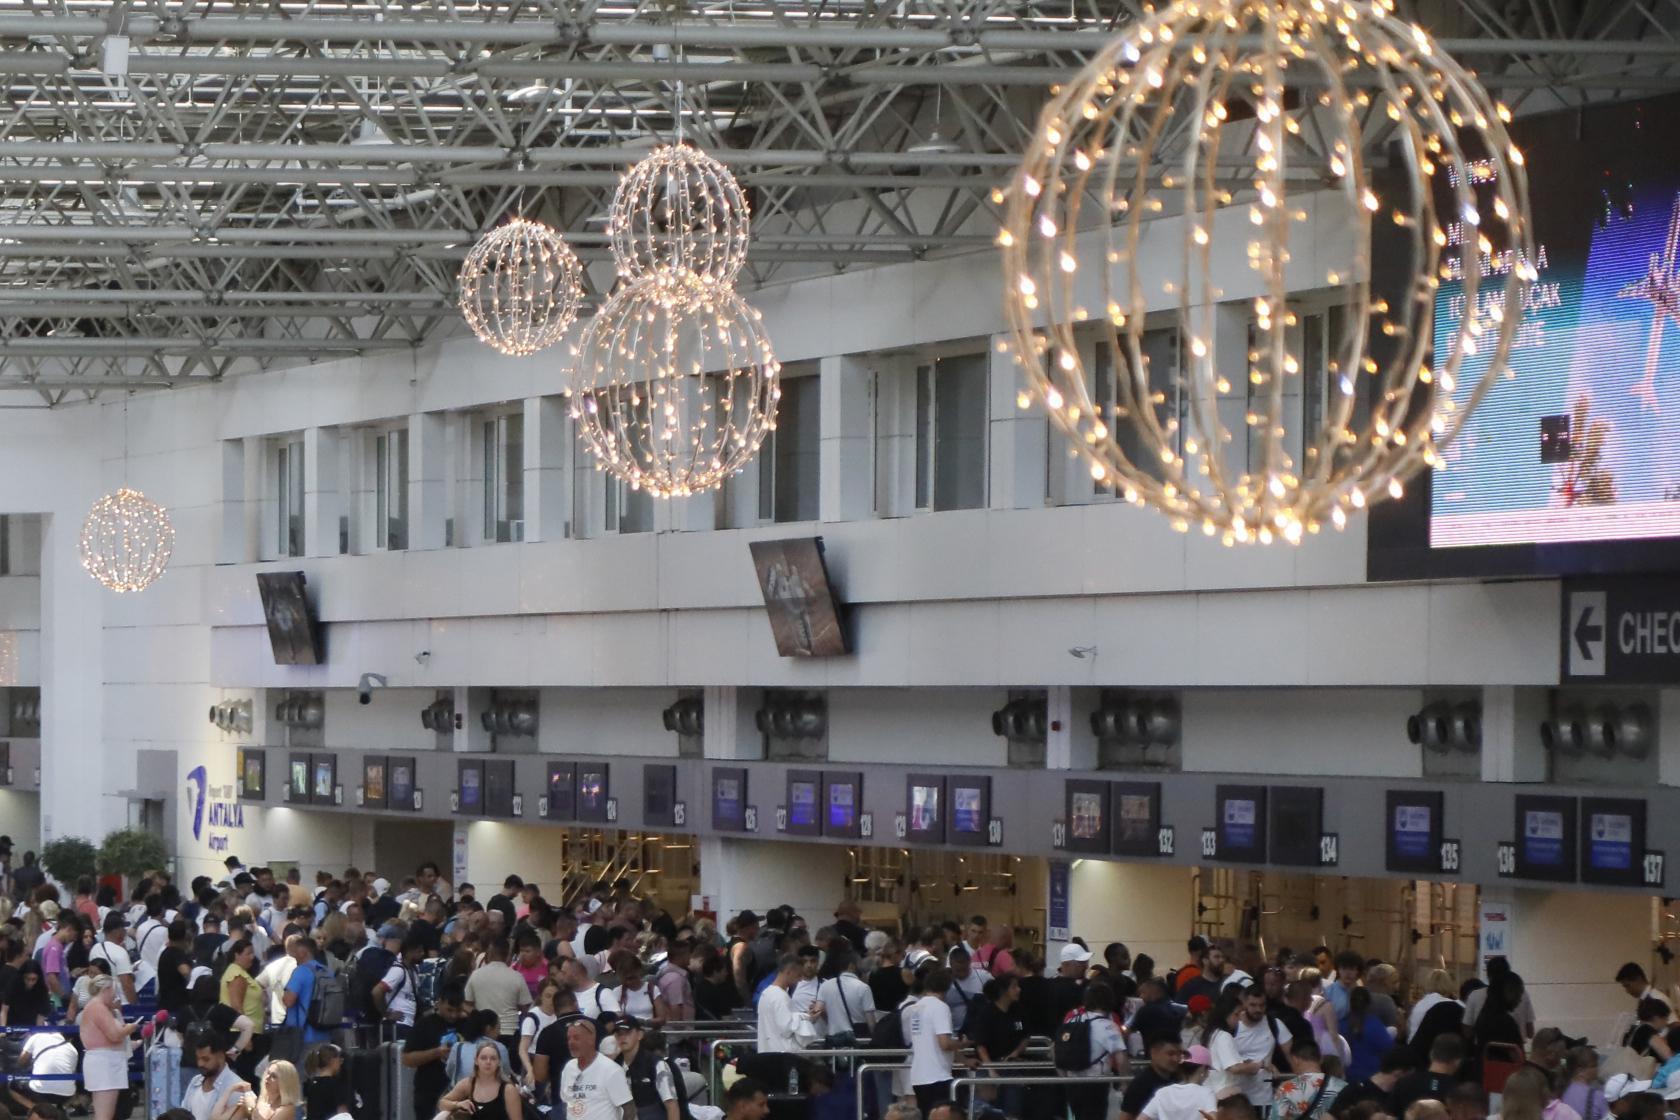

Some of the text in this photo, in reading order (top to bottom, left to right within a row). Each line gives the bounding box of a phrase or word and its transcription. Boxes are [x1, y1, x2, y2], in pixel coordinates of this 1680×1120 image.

[209, 802, 244, 828] ANTALYA
[989, 820, 1002, 843] 130
[1053, 823, 1066, 847] 131
[1159, 828, 1174, 853] 132
[1201, 830, 1216, 856] 133
[1321, 837, 1337, 863] 134
[1441, 843, 1459, 870] 135
[1497, 845, 1515, 873] 136
[1643, 853, 1663, 883] 137
